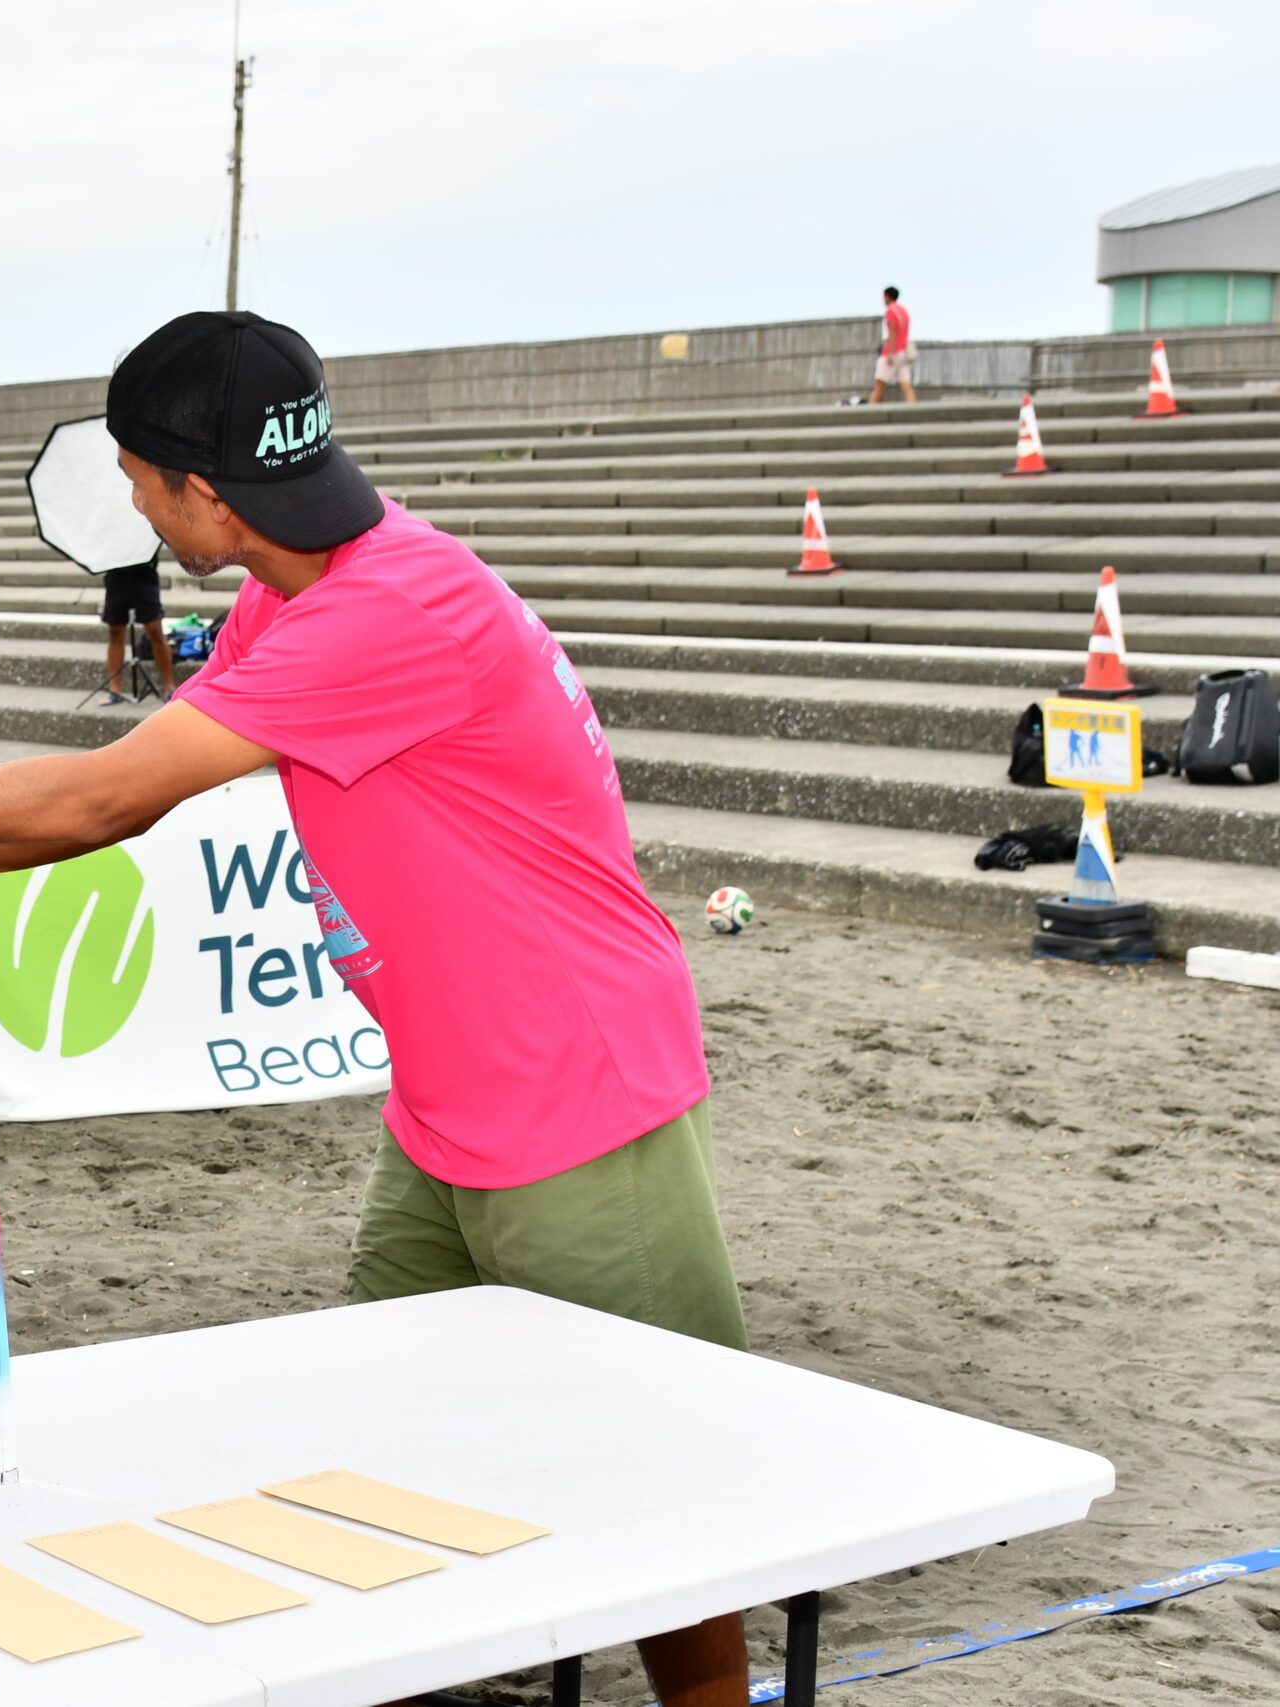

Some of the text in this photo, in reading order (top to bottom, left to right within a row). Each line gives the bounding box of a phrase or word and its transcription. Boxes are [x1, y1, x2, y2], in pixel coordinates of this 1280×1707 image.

[265, 405, 275, 415] IF
[281, 400, 298, 411] YOU
[289, 448, 318, 464] GOTTA
